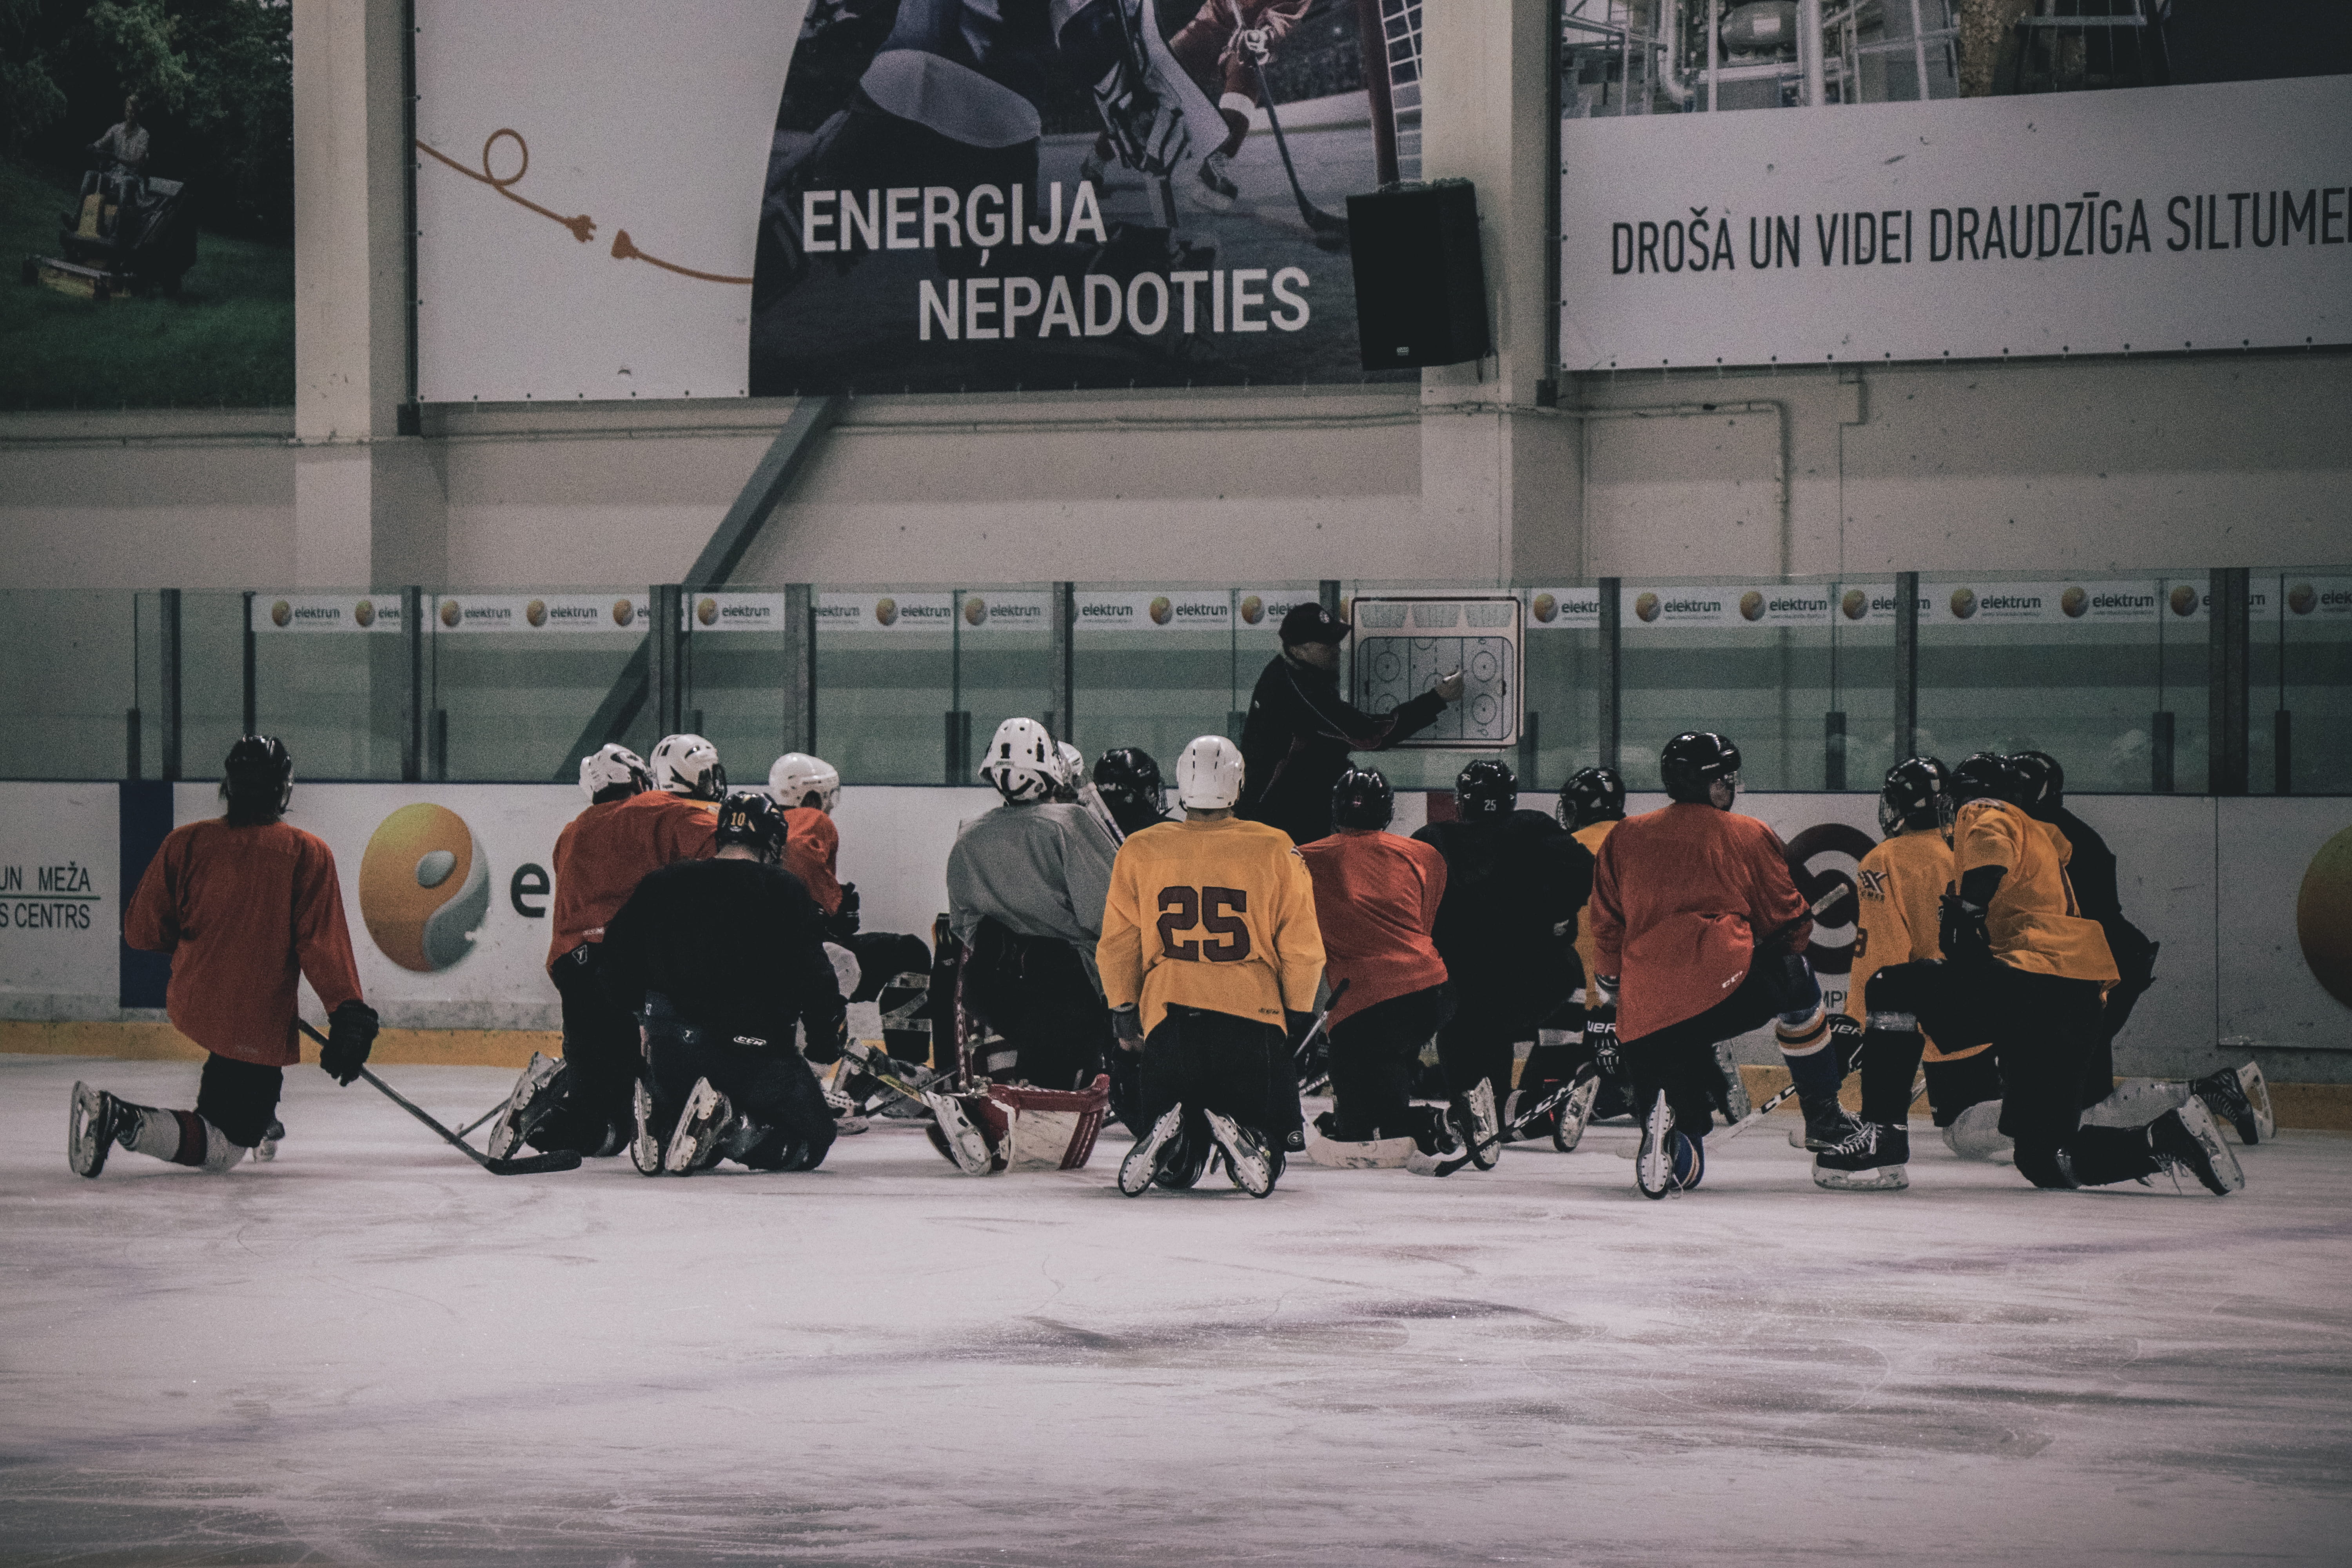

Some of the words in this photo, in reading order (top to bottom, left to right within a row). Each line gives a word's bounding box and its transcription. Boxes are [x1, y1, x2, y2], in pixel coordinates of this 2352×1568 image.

[803, 180, 1107, 267] ENERĢIJA
[1612, 207, 1735, 274] DROŠA
[1750, 215, 1800, 269] UN
[1816, 210, 1912, 267] VIDEI
[1930, 192, 2152, 262] DRAUDZĪGA
[2167, 186, 2352, 251] SILTUME
[919, 267, 1310, 341] NEPADOTIES
[1664, 600, 1721, 612] elektrum
[1769, 598, 1827, 611] elektrum
[1981, 595, 2041, 609] elektrum
[2092, 593, 2154, 607] elektrum
[722, 606, 770, 617] elektrum
[901, 606, 951, 617] elektrum
[990, 605, 1040, 616] elektrum
[1082, 604, 1133, 616] elektrum
[1176, 604, 1227, 615] elektrum
[1484, 799, 1497, 811] 25
[730, 812, 746, 826] 10
[39, 861, 91, 892] MEŽA
[15, 902, 90, 929] CENTRS
[1156, 886, 1251, 962] 25
[736, 1035, 765, 1046] CCM
